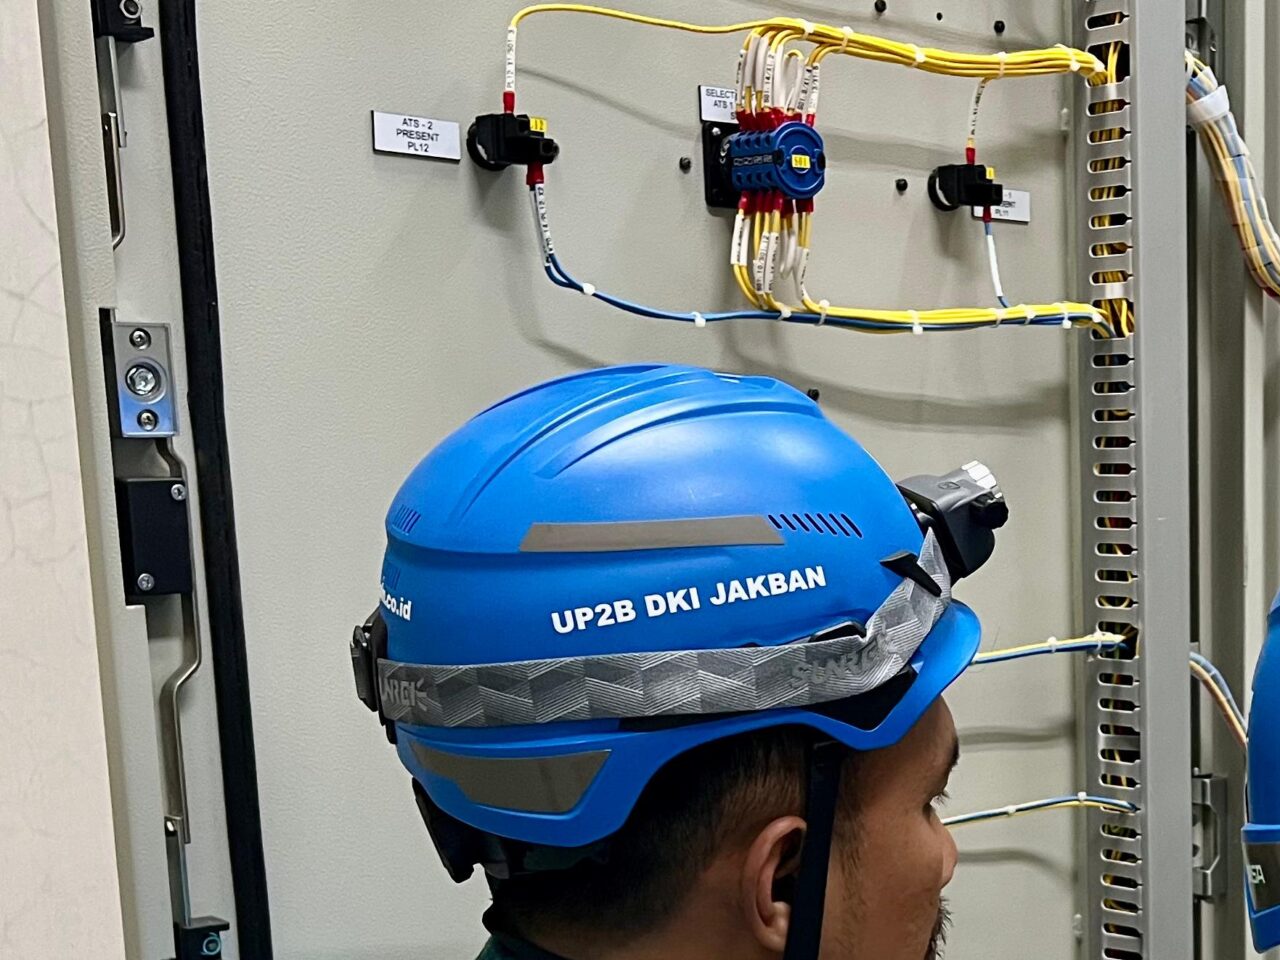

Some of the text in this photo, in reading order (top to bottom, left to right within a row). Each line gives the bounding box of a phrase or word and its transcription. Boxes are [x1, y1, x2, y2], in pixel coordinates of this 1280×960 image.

[402, 117, 420, 129] ATS
[427, 121, 433, 130] 2
[396, 128, 440, 143] PRESENT
[407, 141, 430, 153] PL12
[551, 565, 827, 634] UP2B DKI JAKBAN
